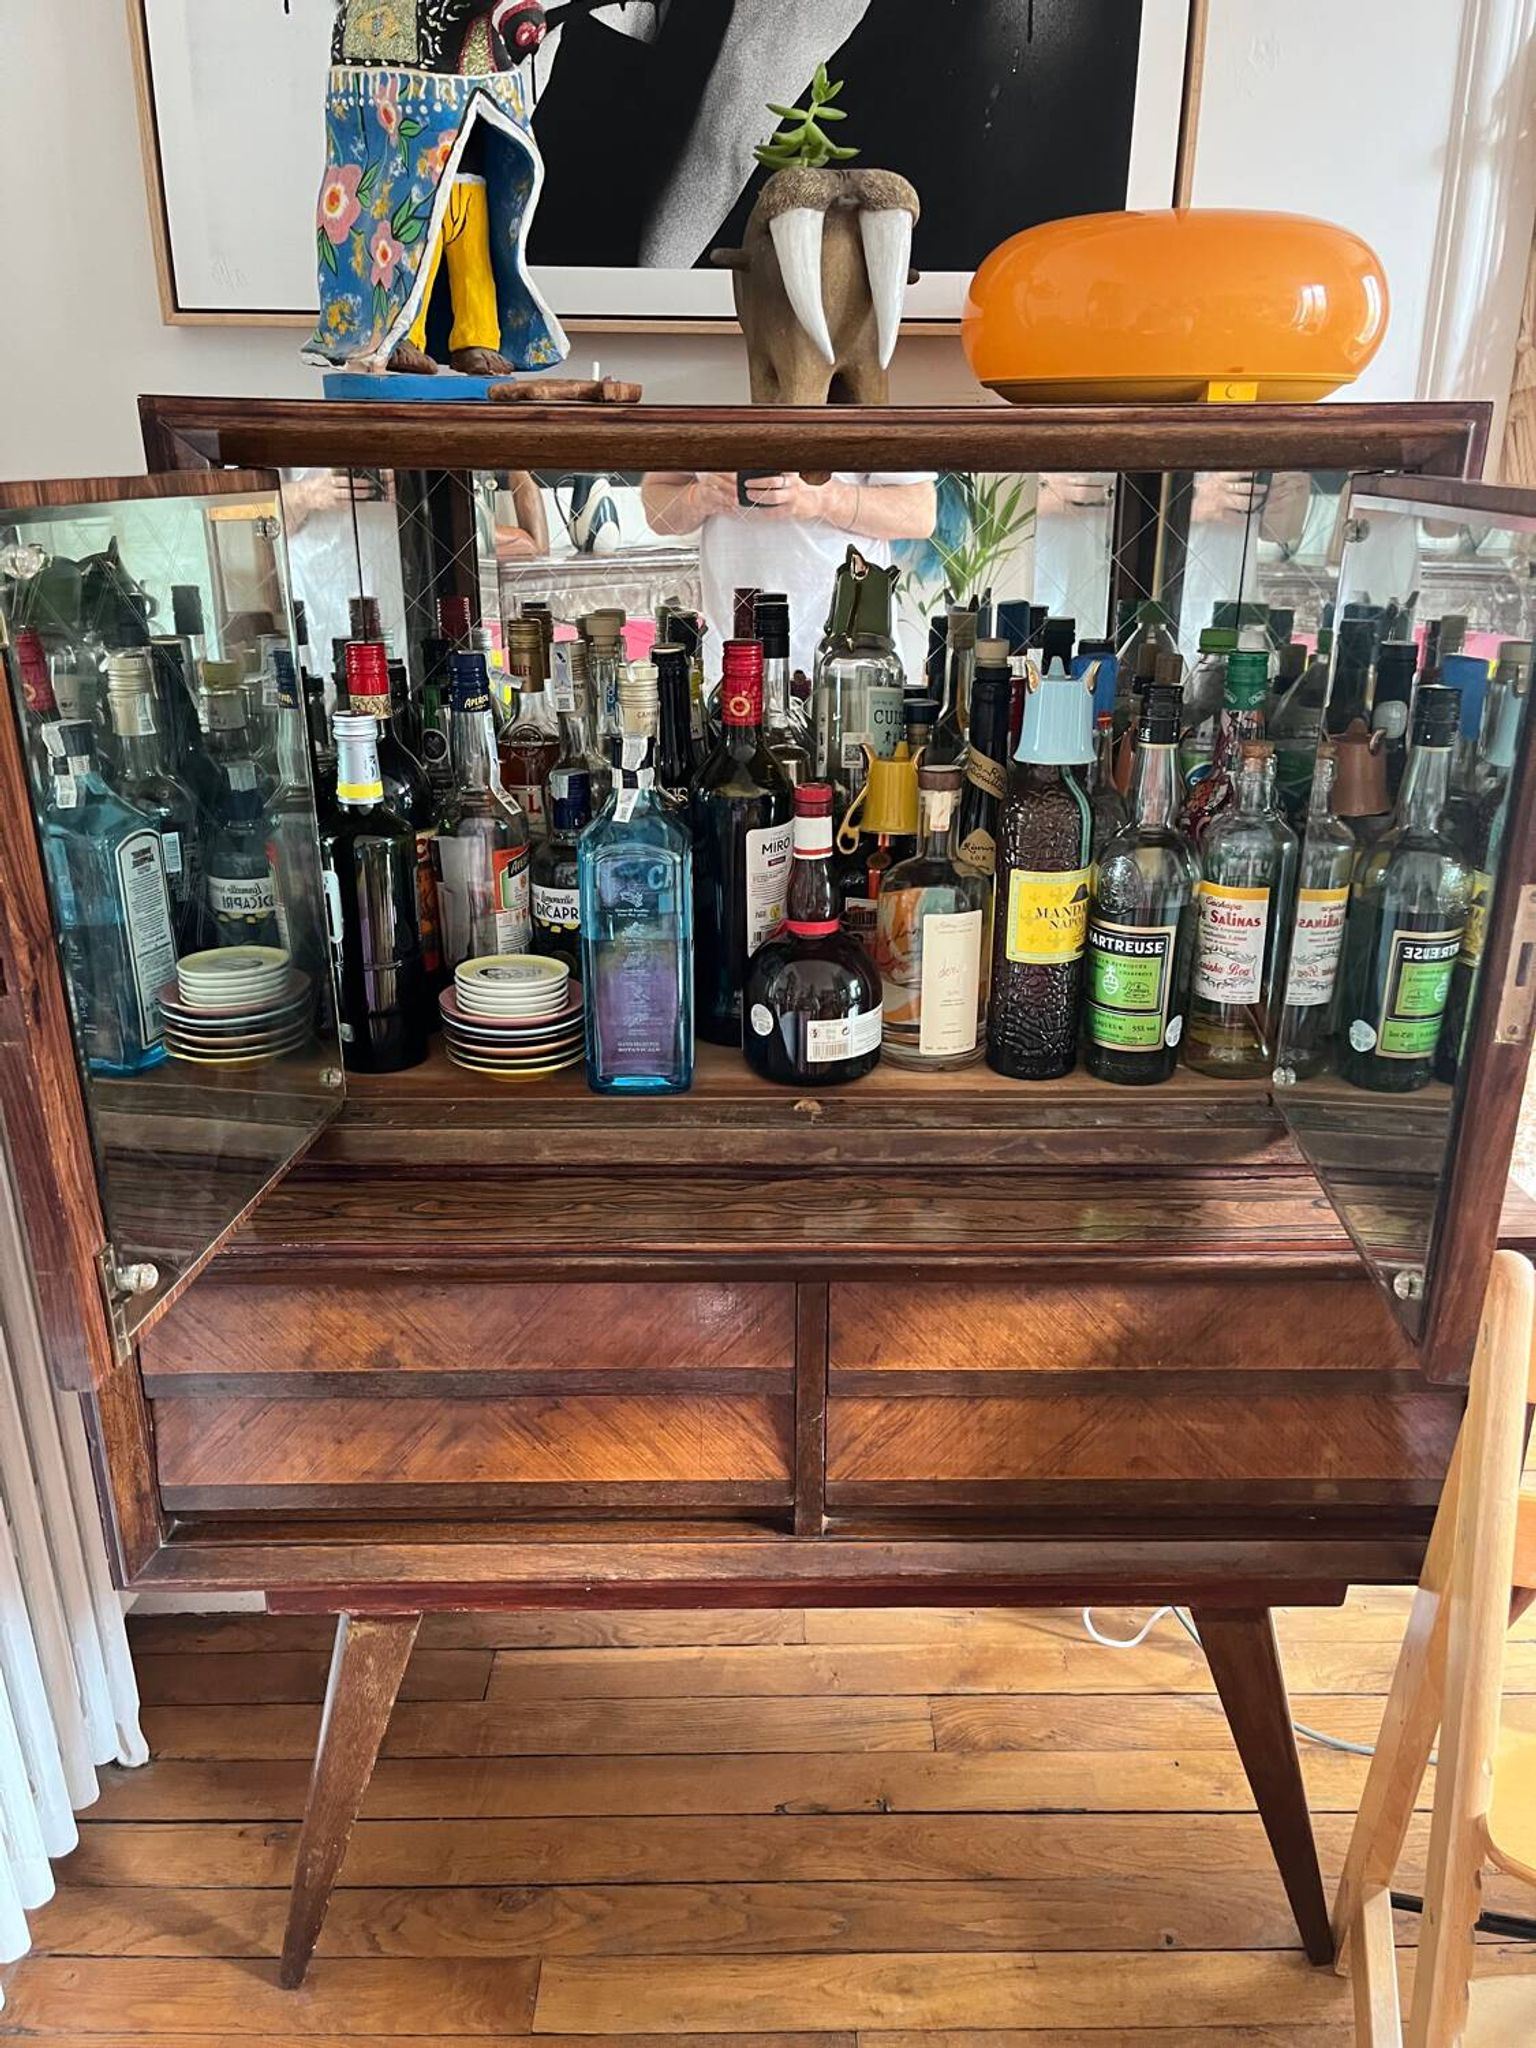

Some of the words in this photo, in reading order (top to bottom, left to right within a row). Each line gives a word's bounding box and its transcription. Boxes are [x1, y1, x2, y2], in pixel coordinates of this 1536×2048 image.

[874, 709, 902, 725] CUI
[536, 902, 579, 919] DICAPR
[1090, 931, 1165, 954] ARTREUSE
